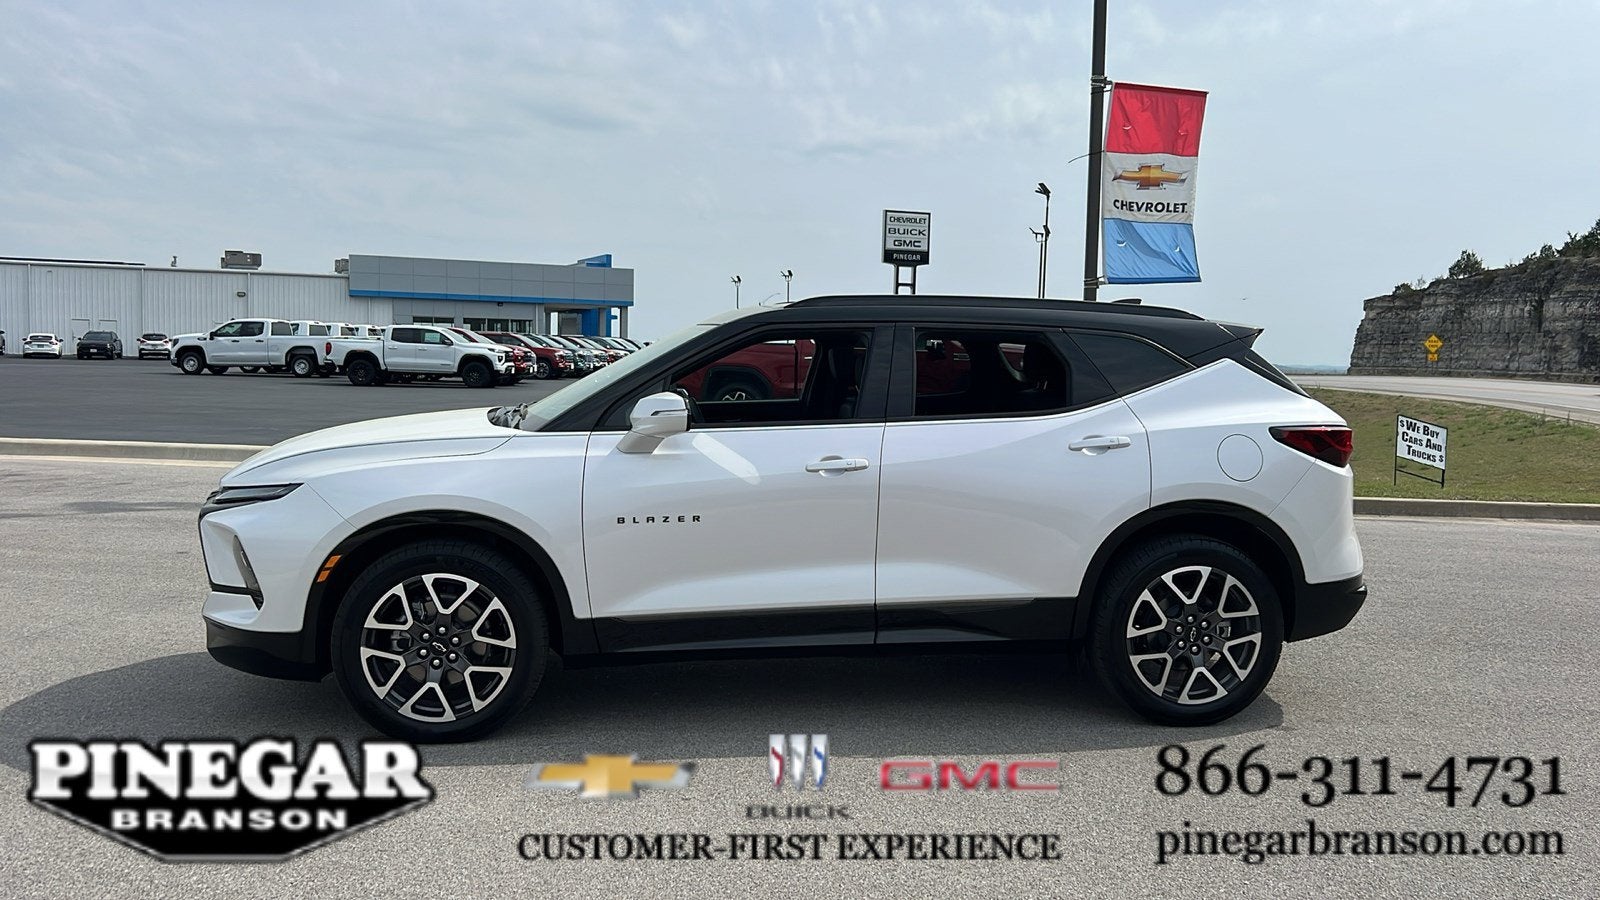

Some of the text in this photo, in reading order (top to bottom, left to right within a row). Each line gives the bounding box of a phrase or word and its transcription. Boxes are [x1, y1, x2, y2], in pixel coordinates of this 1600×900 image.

[889, 216, 927, 225] CHEVROLET
[888, 227, 927, 236] BUICK
[893, 239, 922, 248] GMC
[617, 515, 701, 524] BLAZER
